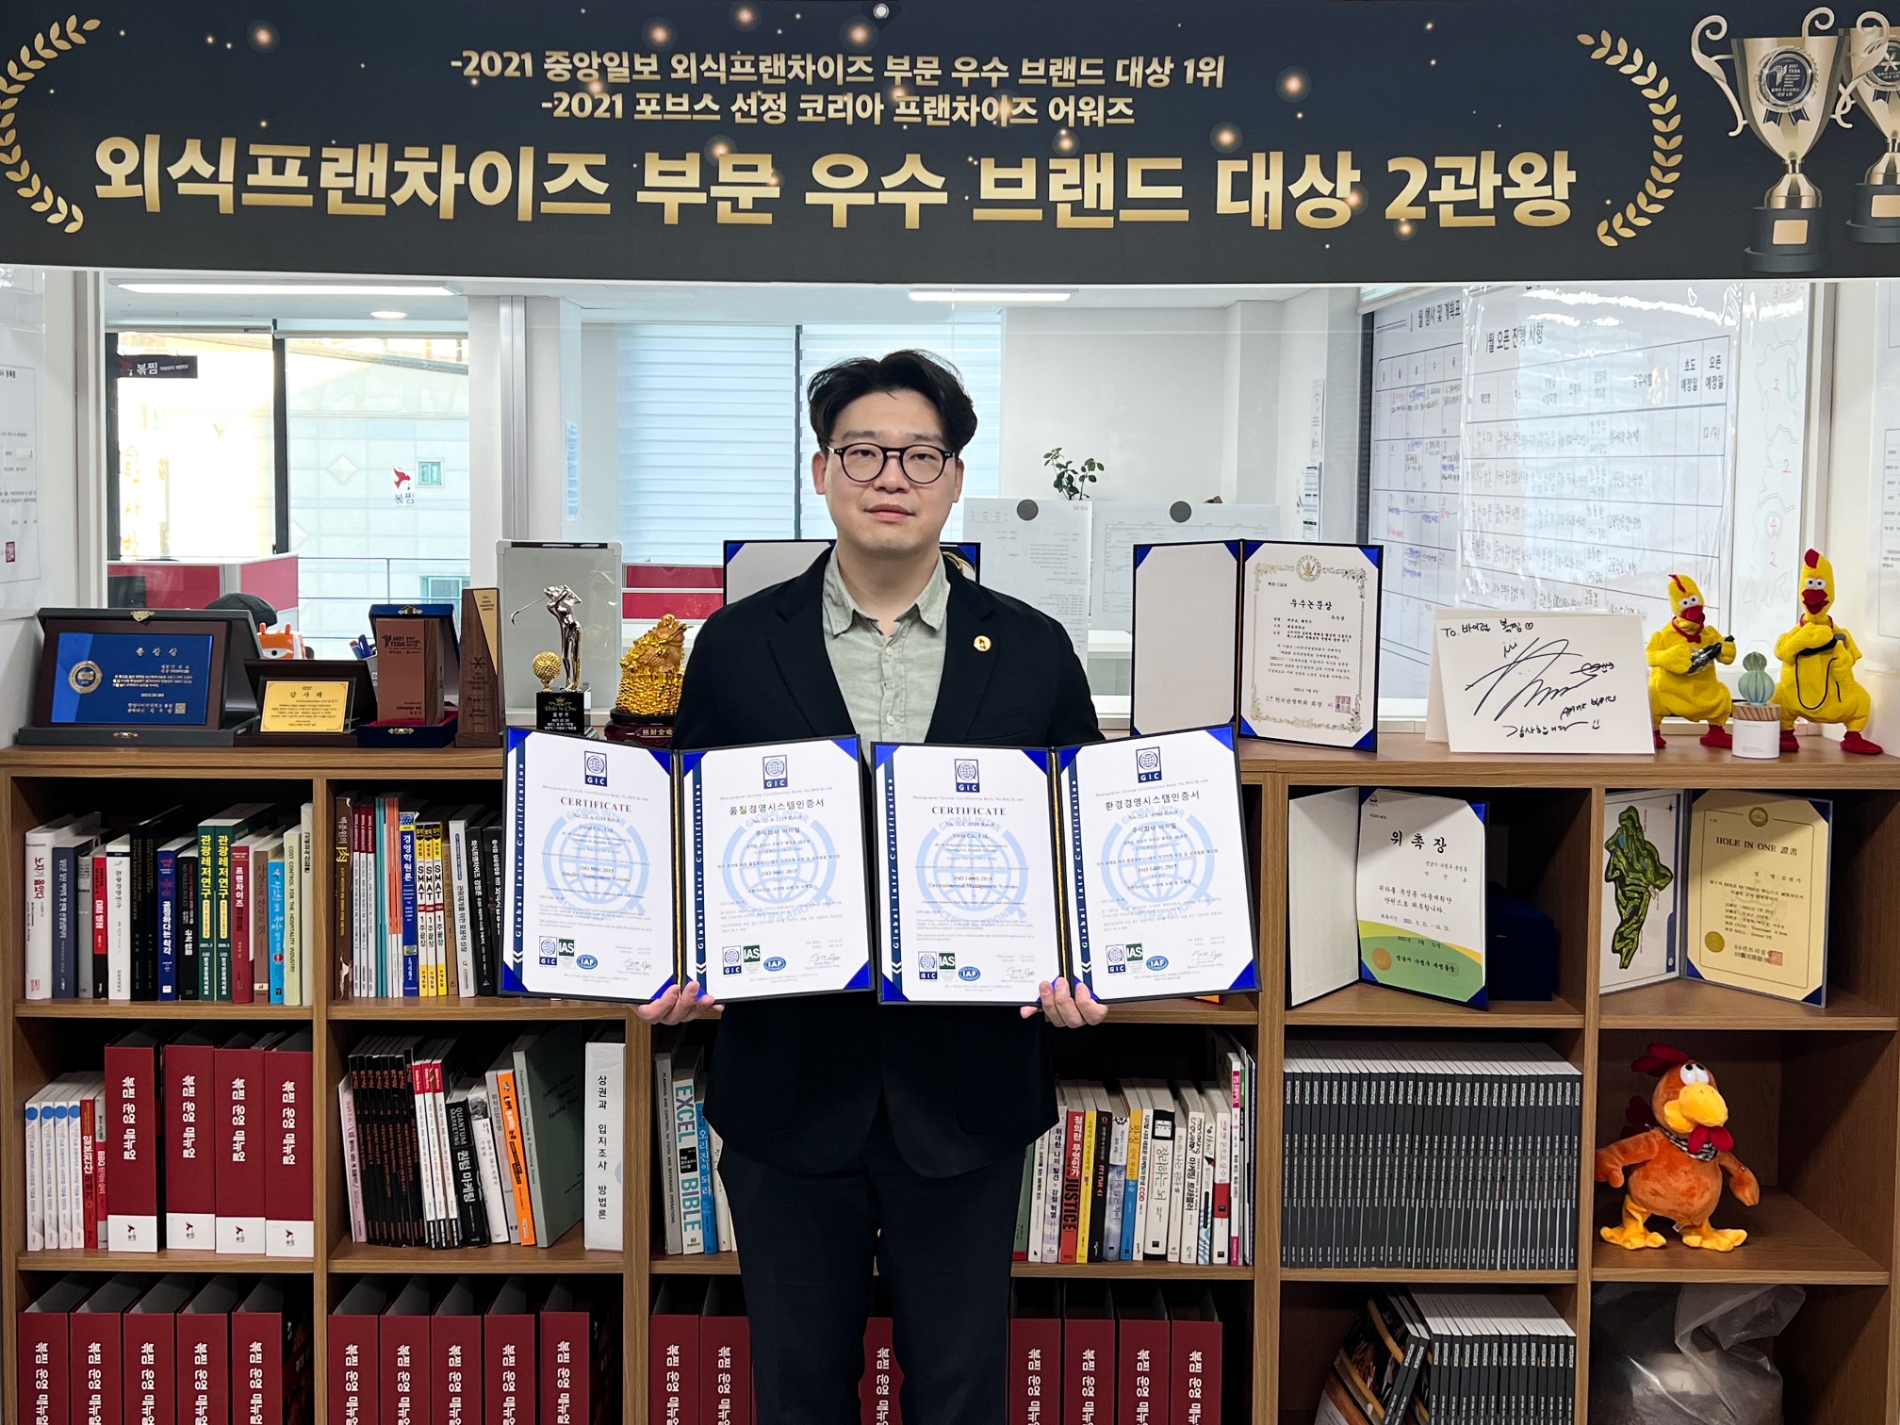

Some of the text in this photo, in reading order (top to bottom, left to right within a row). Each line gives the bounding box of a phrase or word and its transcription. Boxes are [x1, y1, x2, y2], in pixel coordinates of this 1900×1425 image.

[451, 51, 1224, 90] -2021 중앙일보 외식프랜차이즈 부문 우수 브랜드 대상 1위
[542, 90, 1134, 130] -2021 포브스 선정 코리아 프랜차이즈 어워즈
[95, 135, 1576, 230] 외식프랜차이즈 부문 우수 브랜드 대상 2관왕
[1497, 329, 1510, 351] 오픈
[1511, 323, 1526, 349] 진행
[1528, 321, 1544, 344] 사항
[1709, 354, 1722, 370] 오픈
[1705, 374, 1724, 390] 예정일
[1782, 459, 1791, 474] 2
[1290, 599, 1332, 611] 우수논문상
[587, 776, 605, 785] GIC
[1140, 772, 1160, 781] GIC
[560, 796, 632, 813] CERTIFICATE
[729, 798, 824, 816] 품질경영시스템인증서
[931, 806, 1007, 816] CERTIFICATE
[1105, 790, 1200, 811] 환경경영시스템인증서
[403, 835, 412, 882] 경영학원론
[1716, 836, 1740, 847] HOLE
[1743, 840, 1754, 849] IN
[1757, 842, 1777, 853] ONE
[34, 857, 44, 899] 노자가 옳았다
[201, 835, 211, 898] 관광레저연구
[219, 835, 229, 898] 관광레저연구
[417, 866, 425, 900] SMAT
[559, 941, 574, 954] IAS
[744, 948, 760, 960] IAS
[939, 955, 956, 966] IAS
[1127, 946, 1143, 959] IAS
[1150, 959, 1164, 967] IAF
[123, 1077, 136, 1159] 볶찜 운영 매뉴얼
[183, 1075, 195, 1158] 볶찜 운영 매뉴얼
[232, 1078, 245, 1161] 볶찜 운영 매뉴얼
[283, 1081, 295, 1164] 볶찜 운영 매뉴얼
[449, 1108, 460, 1145] MARKETING
[456, 1107, 466, 1145] QUANTUM
[597, 1074, 608, 1220] 상권과 입지조사 방법론
[675, 1085, 701, 1232] EXCEL BIBLE
[1071, 1116, 1083, 1177] 정의란 무엇인가
[457, 1150, 475, 1203] 퀀텀 마케팅
[1154, 1145, 1169, 1201] 정리하는 뇌
[1185, 1157, 1195, 1211] 마케팅 트래블러
[1063, 1178, 1078, 1230] JUSTICE
[36, 1342, 48, 1363] 볶찜
[89, 1343, 101, 1364] 볶찜
[141, 1343, 154, 1364] 볶찜
[195, 1343, 207, 1364] 볶찜
[250, 1342, 262, 1363] 볶찜
[558, 1341, 569, 1362] 볶찜
[36, 1369, 48, 1389] 운영
[89, 1369, 101, 1389] 운영
[142, 1369, 154, 1390] 운영
[195, 1369, 207, 1390] 운영
[250, 1368, 262, 1388] 운영
[346, 1344, 358, 1391] 볶찜 운영
[449, 1345, 461, 1392] 볶찜 운영
[558, 1368, 569, 1388] 운영
[667, 1345, 679, 1391] 볶찜 운영
[877, 1348, 889, 1394] 볶찜 운영
[1028, 1349, 1040, 1396] 볶찜 운영
[1137, 1350, 1149, 1397] 볶찜 운영
[1189, 1351, 1202, 1398] 볶찜 운영
